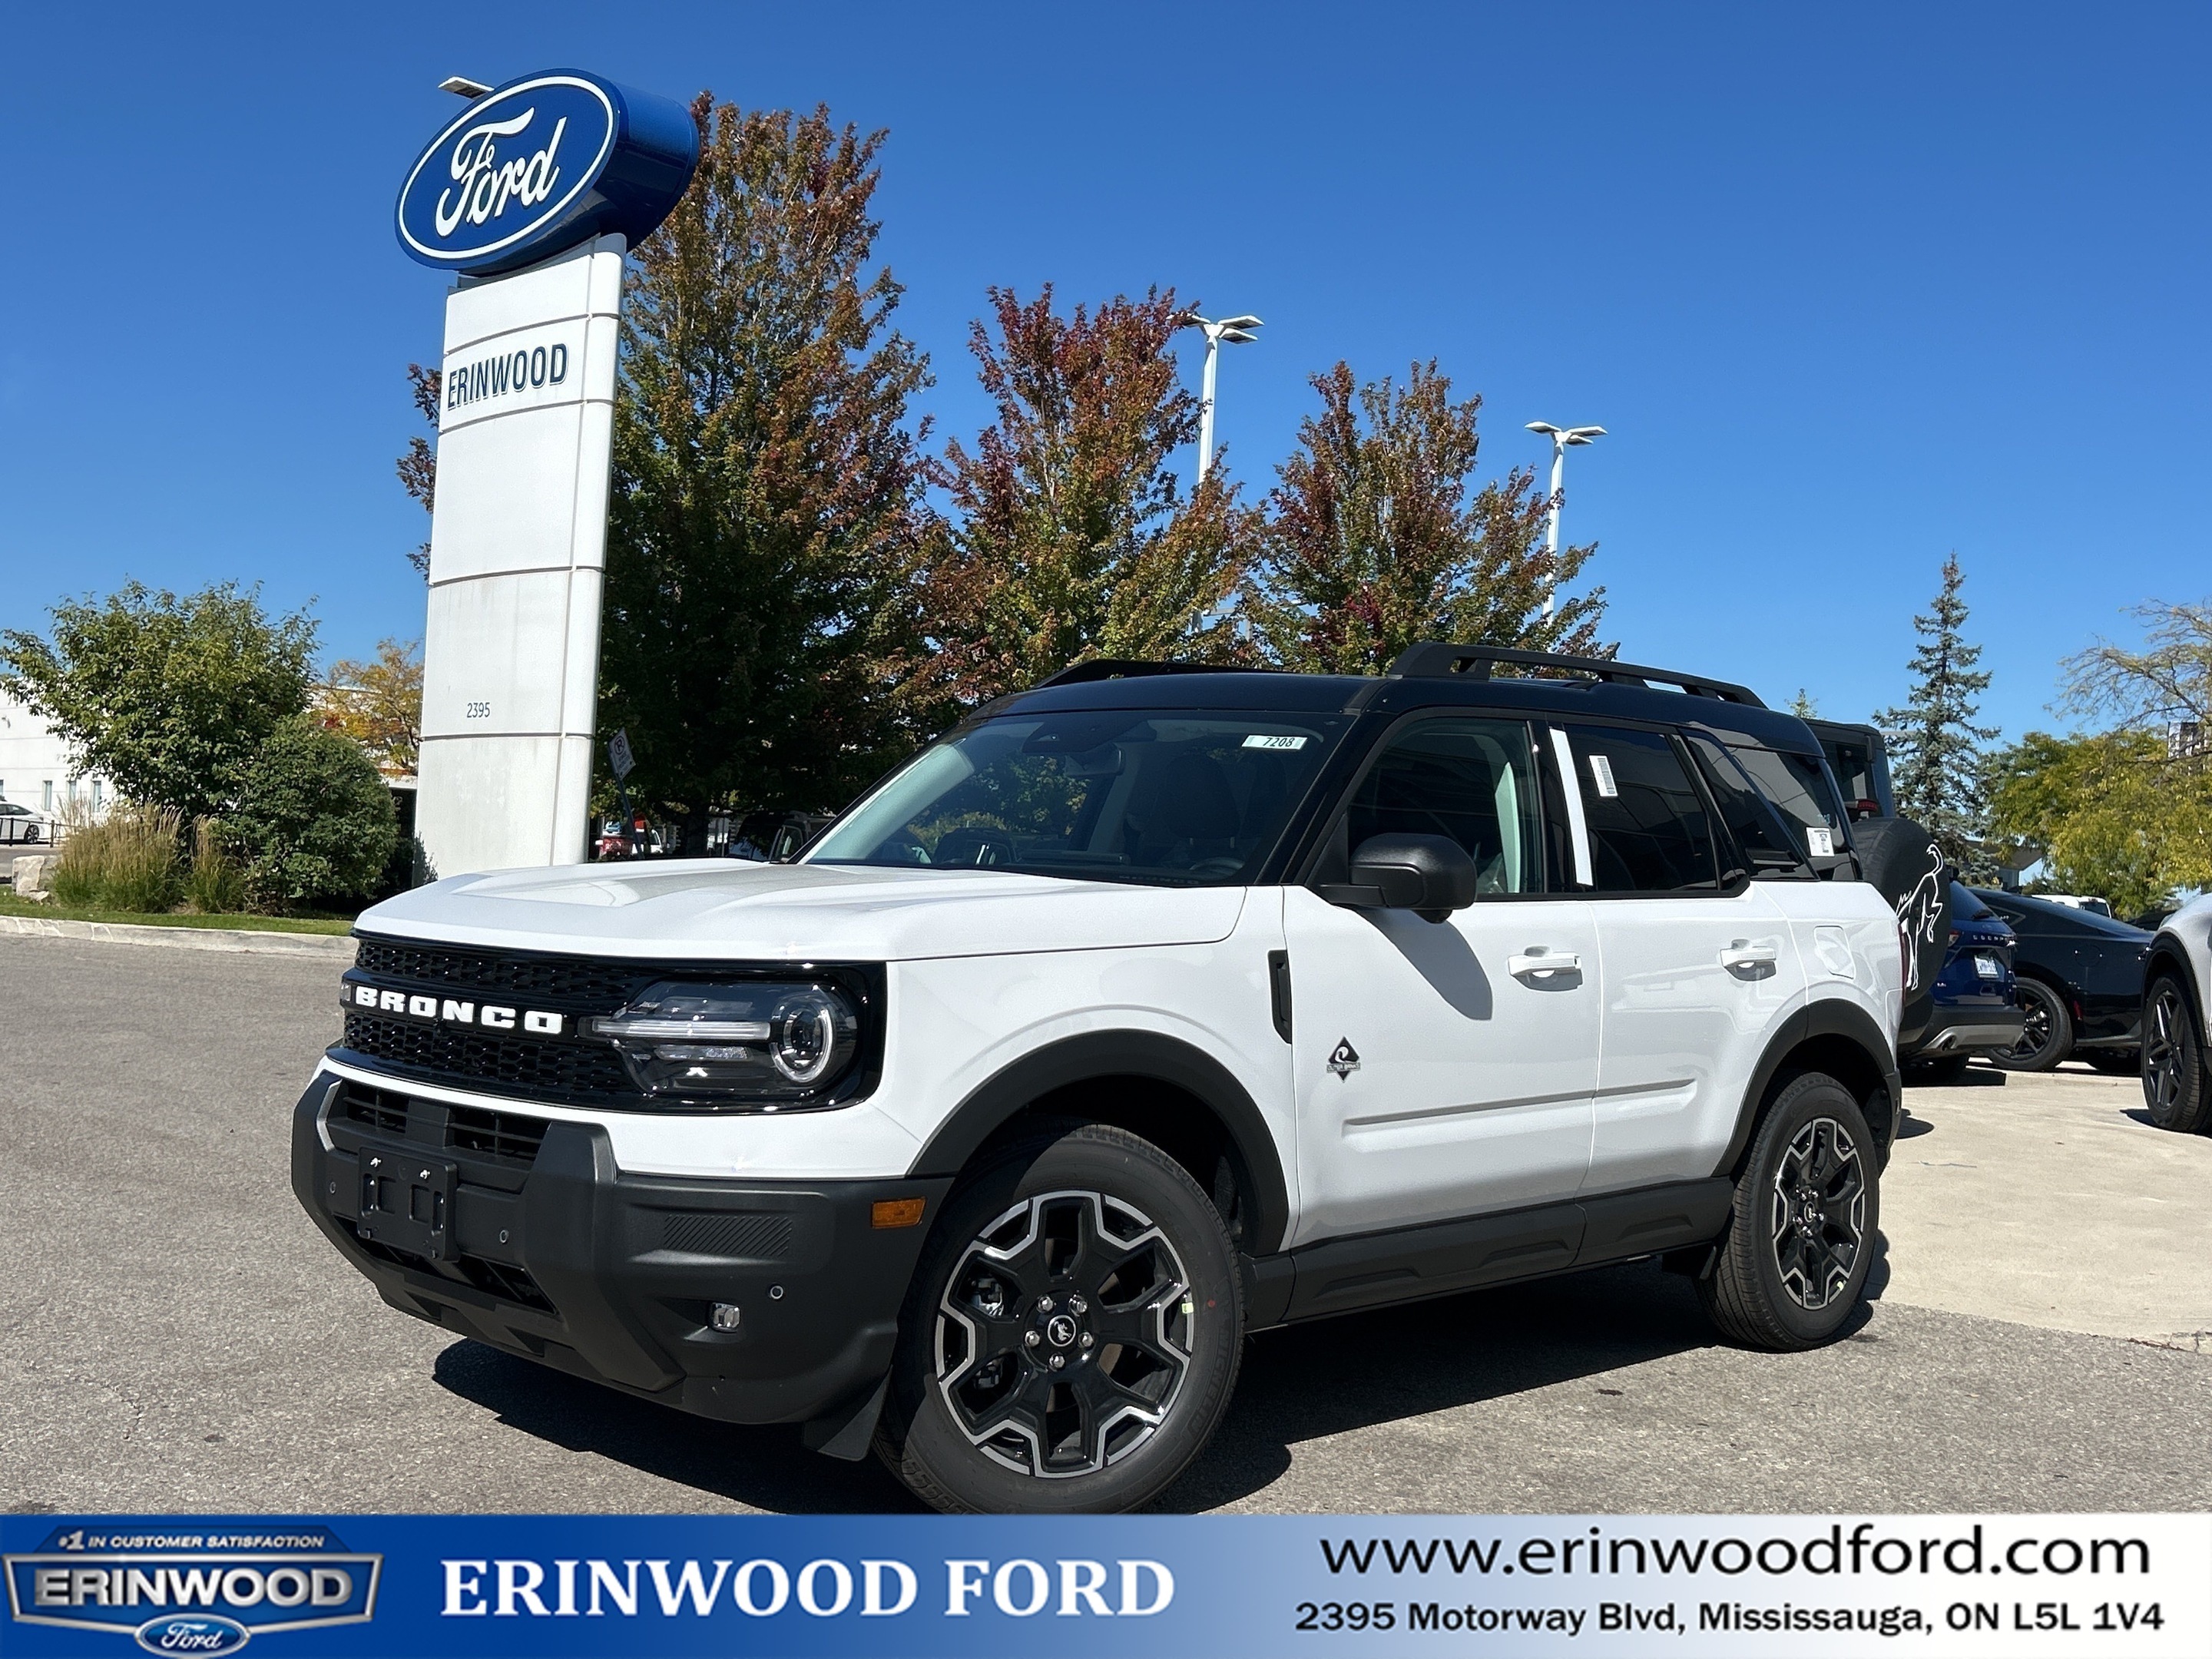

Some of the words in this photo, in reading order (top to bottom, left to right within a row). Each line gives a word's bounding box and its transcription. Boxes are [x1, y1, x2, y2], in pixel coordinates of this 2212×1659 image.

[435, 106, 568, 237] Ford
[446, 343, 569, 411] ERINWOOD
[466, 702, 490, 718] 2395
[1262, 737, 1296, 747] 7208
[355, 985, 563, 1035] BRONCO
